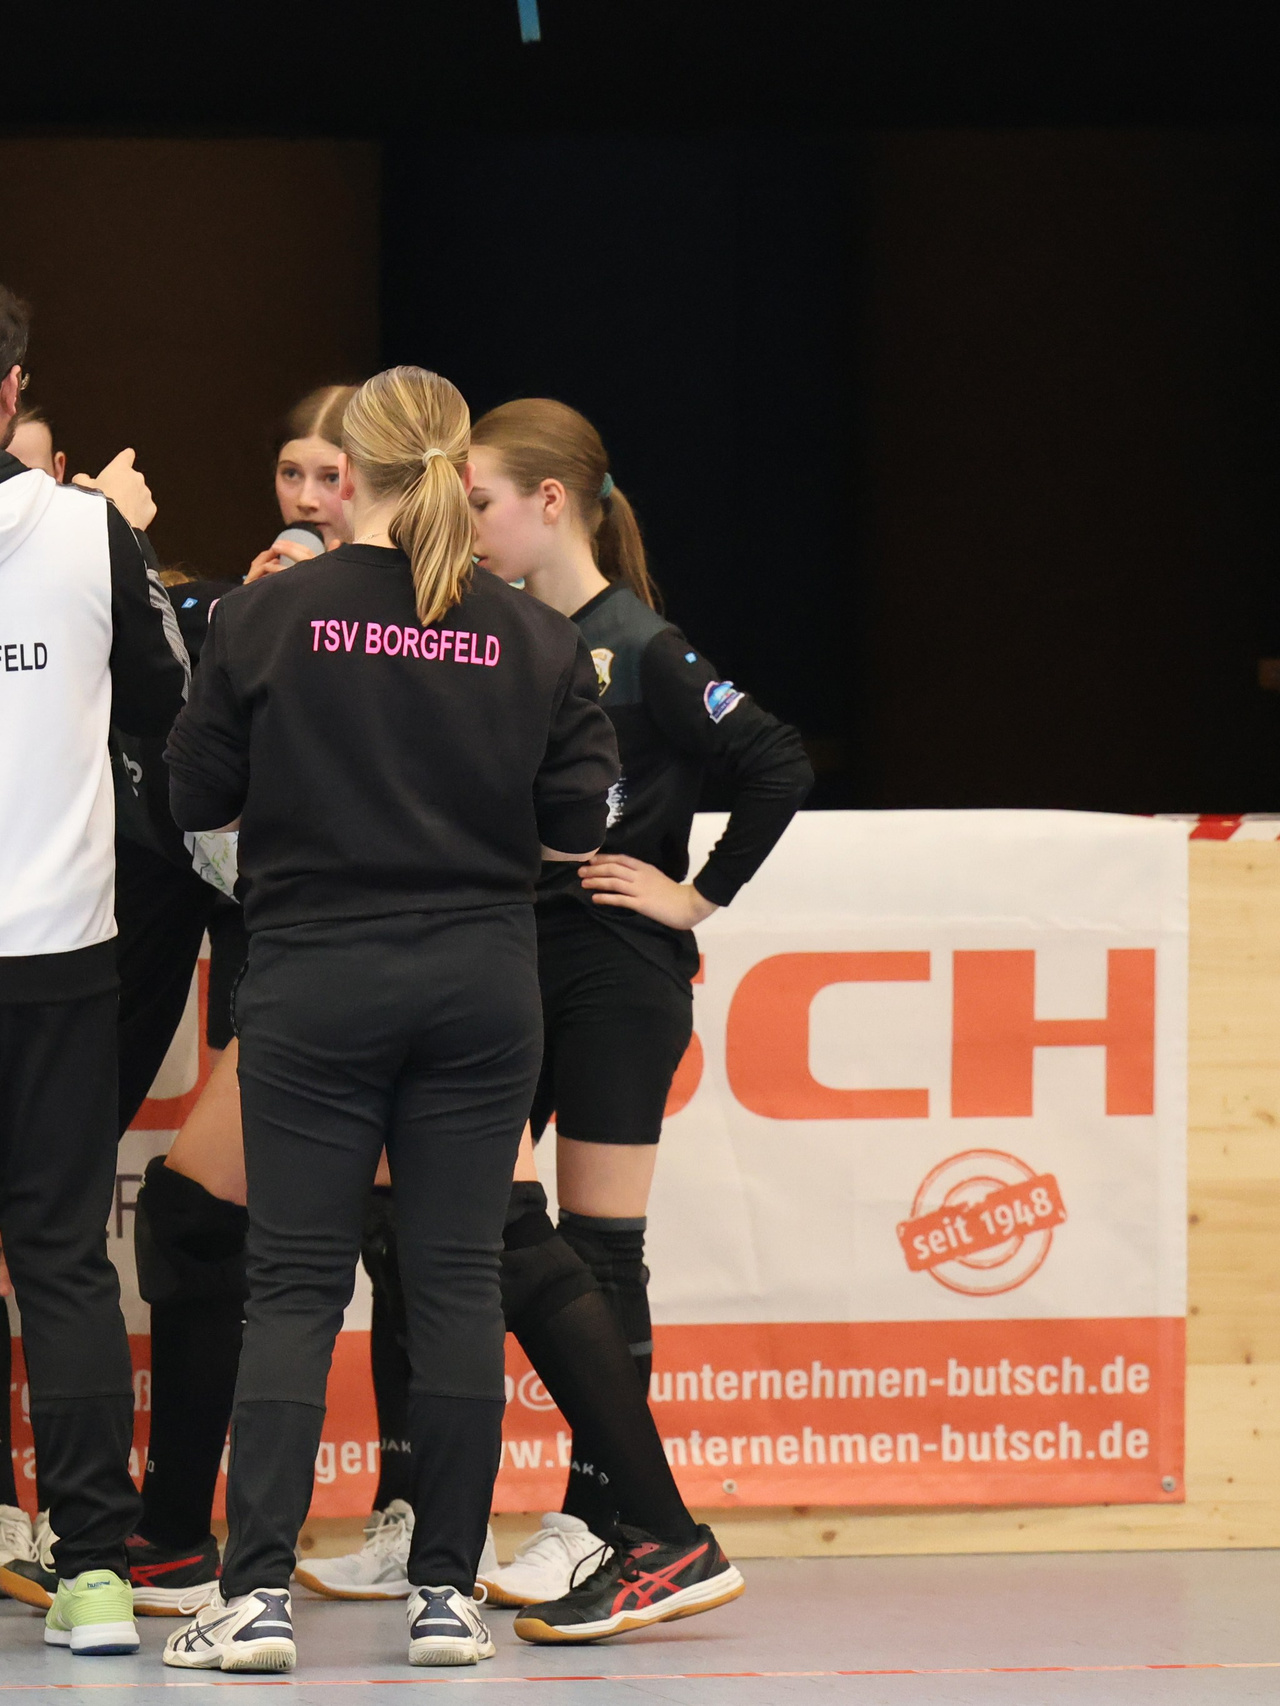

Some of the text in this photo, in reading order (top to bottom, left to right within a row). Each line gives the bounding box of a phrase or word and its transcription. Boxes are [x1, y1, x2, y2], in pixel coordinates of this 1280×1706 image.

[310, 620, 502, 668] TSV BORGFELD
[913, 1187, 1052, 1260] seit 1948
[380, 1438, 411, 1454] JAK
